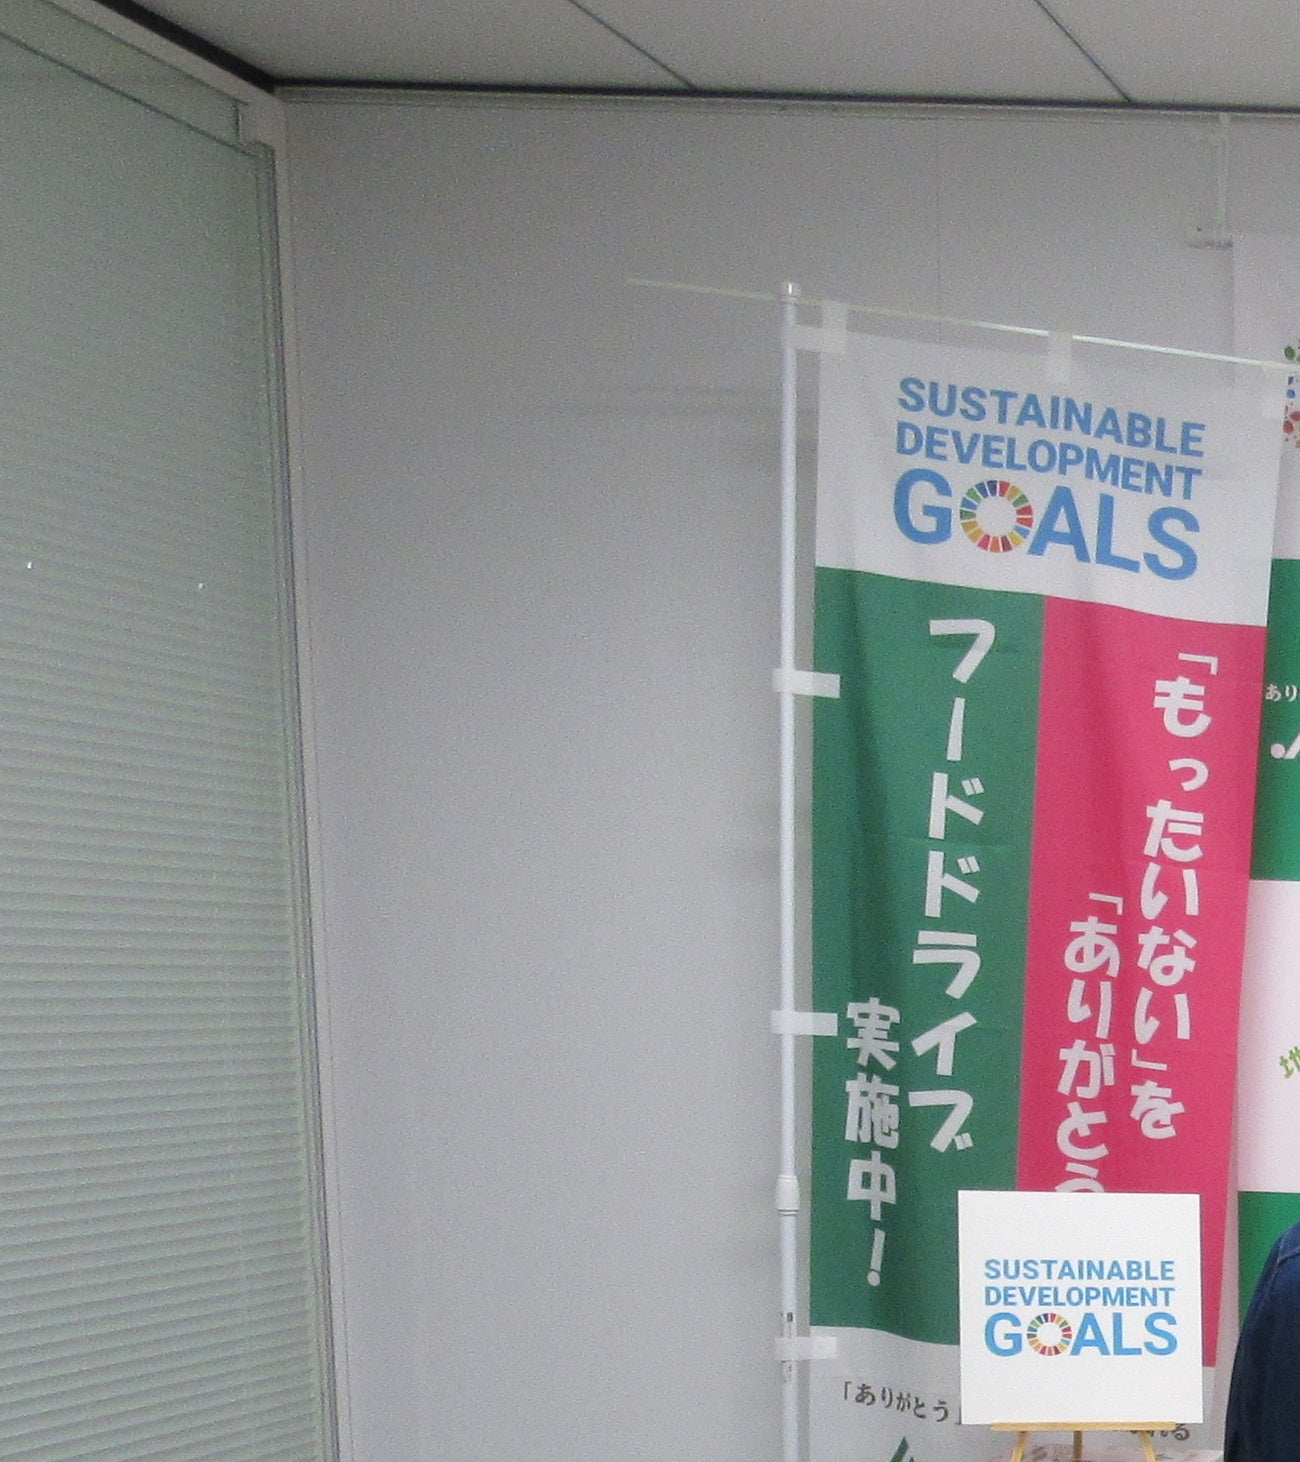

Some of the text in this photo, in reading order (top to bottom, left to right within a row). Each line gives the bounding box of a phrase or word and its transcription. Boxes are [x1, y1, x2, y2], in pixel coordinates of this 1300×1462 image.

[897, 376, 1206, 458] SUSTAINABLE
[895, 420, 1202, 500] DEVELOPMENT
[893, 467, 1200, 580] GOALS
[908, 618, 996, 1153] フードドライブ
[1130, 652, 1218, 1140] 「もったいない」を
[985, 1259, 1176, 1282] SUSTAINABLE
[985, 1286, 1176, 1308] DEVELOPMENT
[984, 1311, 1178, 1358] GOALS
